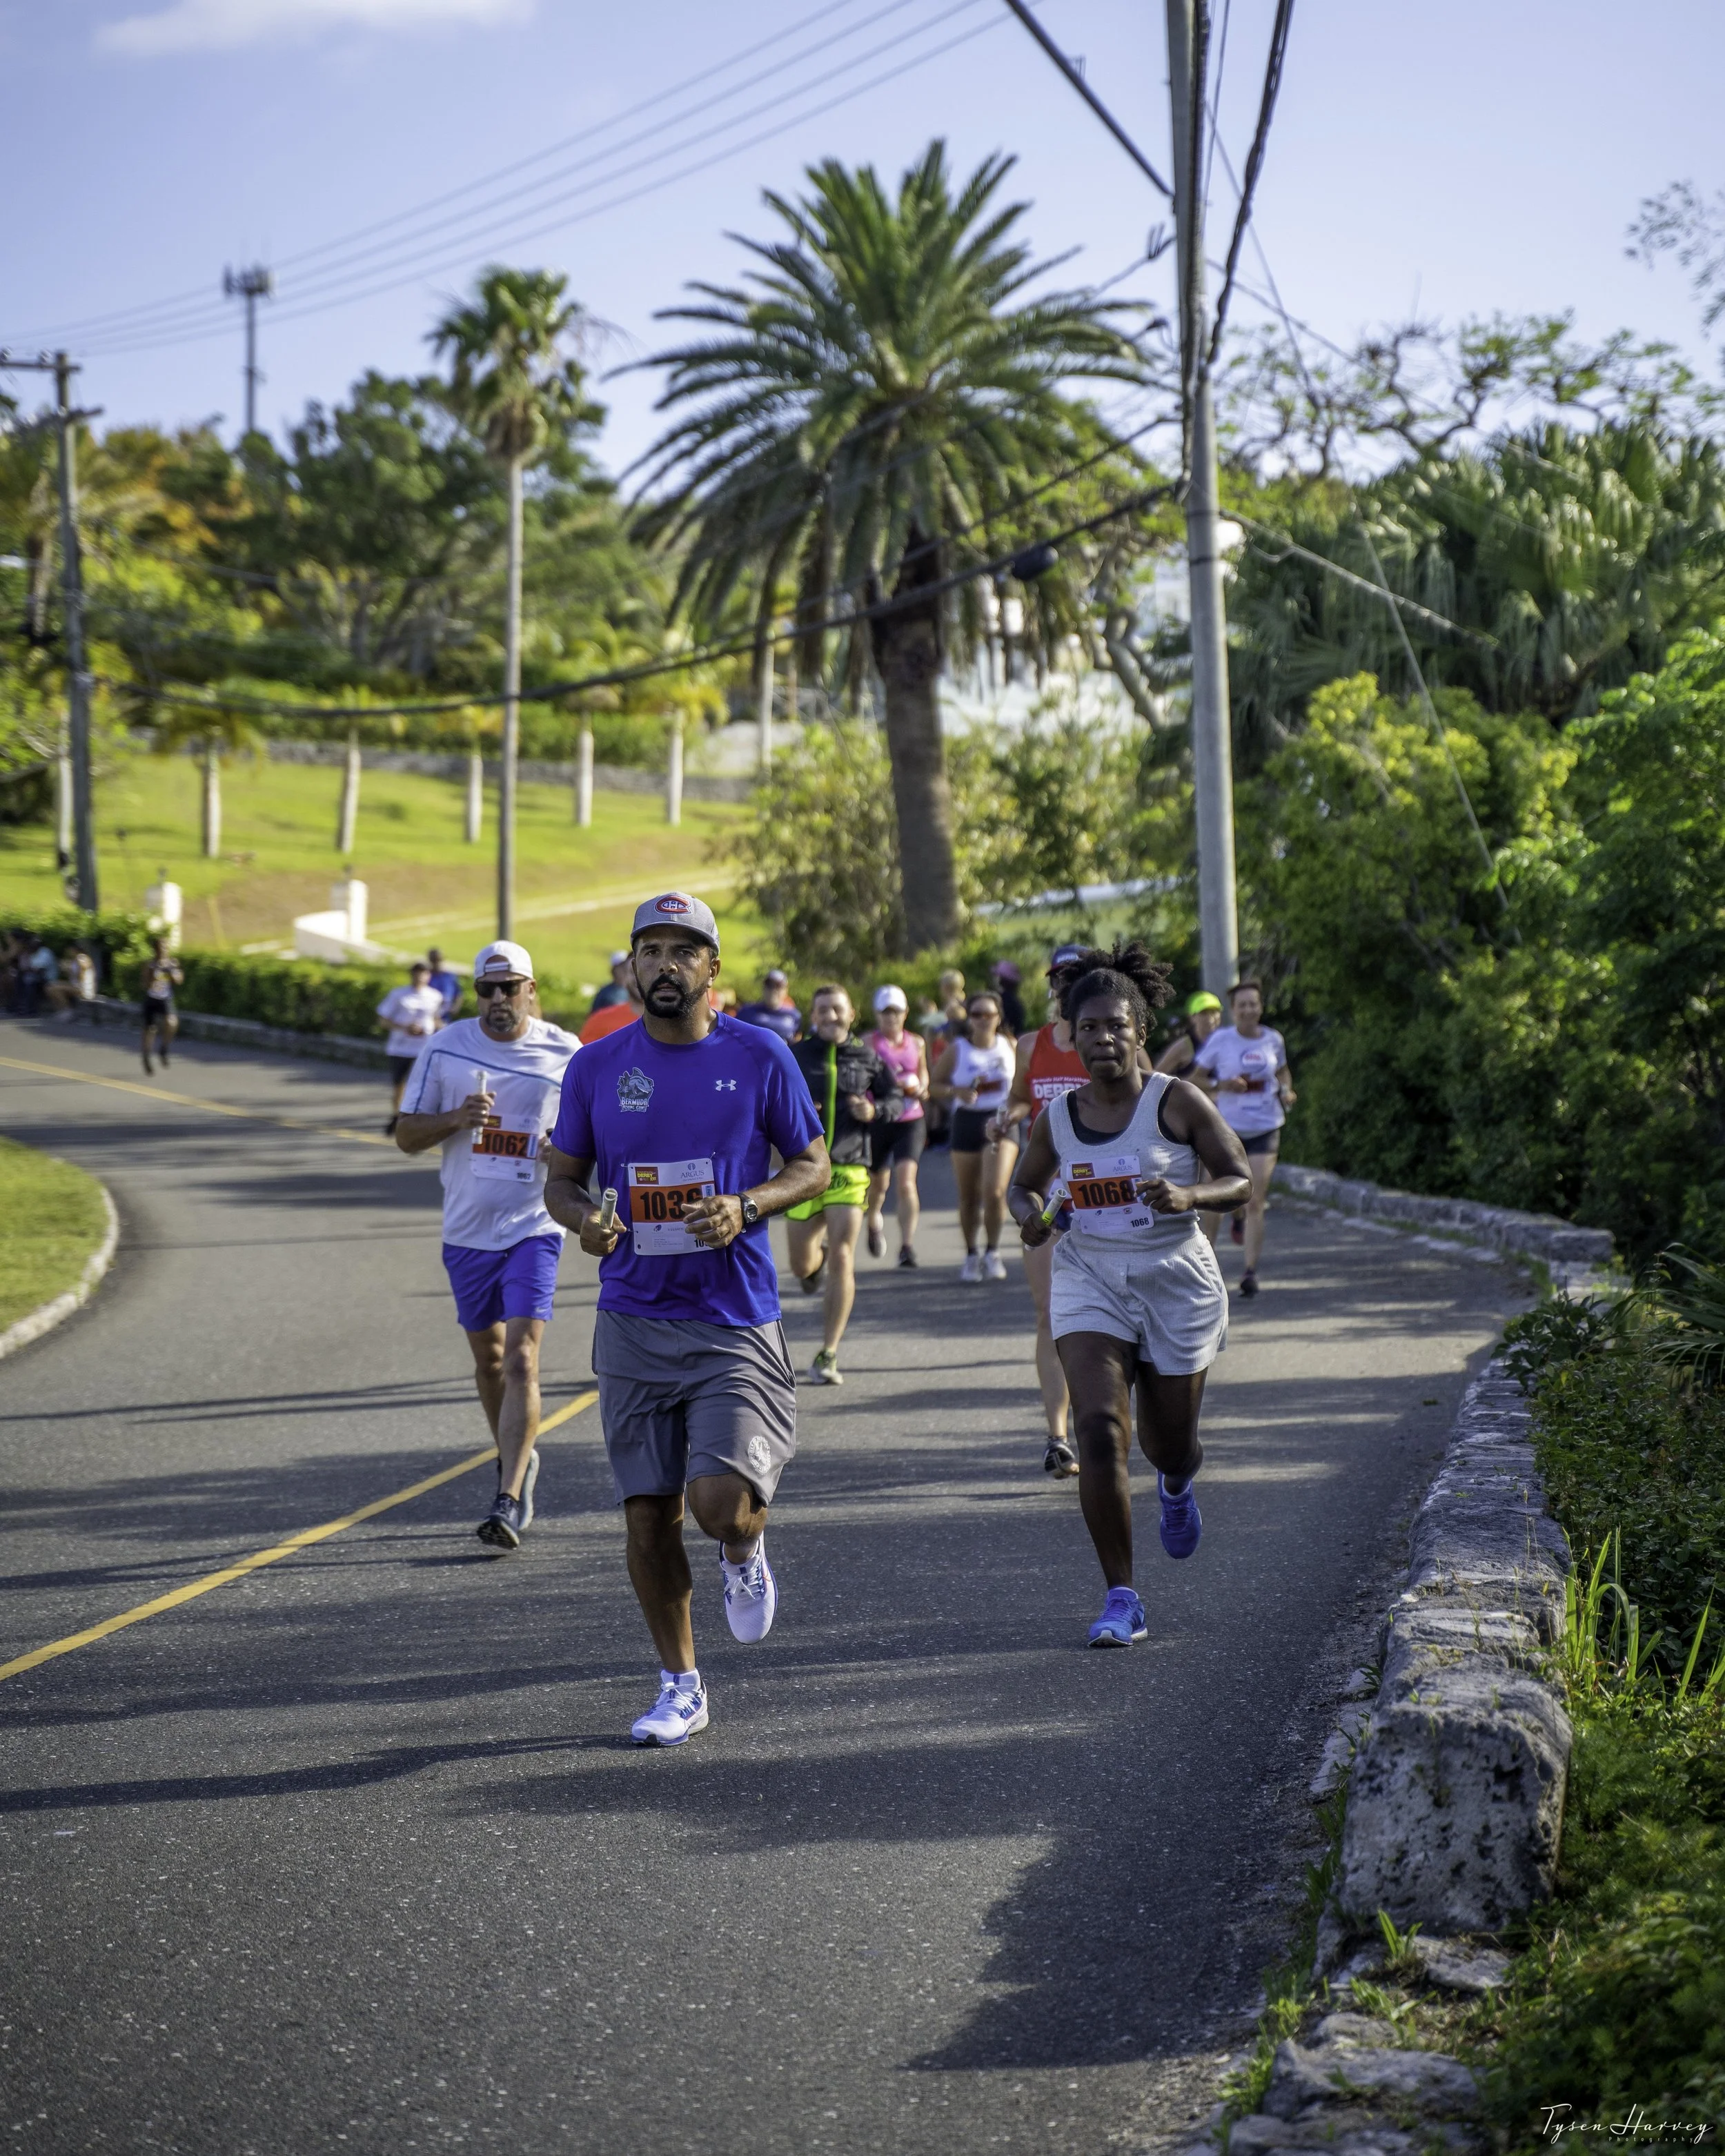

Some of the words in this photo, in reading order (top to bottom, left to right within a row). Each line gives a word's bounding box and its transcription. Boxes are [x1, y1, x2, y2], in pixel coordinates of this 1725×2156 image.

[1034, 1083, 1081, 1098] DER
[621, 1097, 648, 1105] BERMUDA
[484, 1133, 529, 1157] 1062
[680, 1169, 705, 1179] ARGUS
[1078, 1180, 1136, 1207] 1068
[1130, 1217, 1150, 1228] 1068
